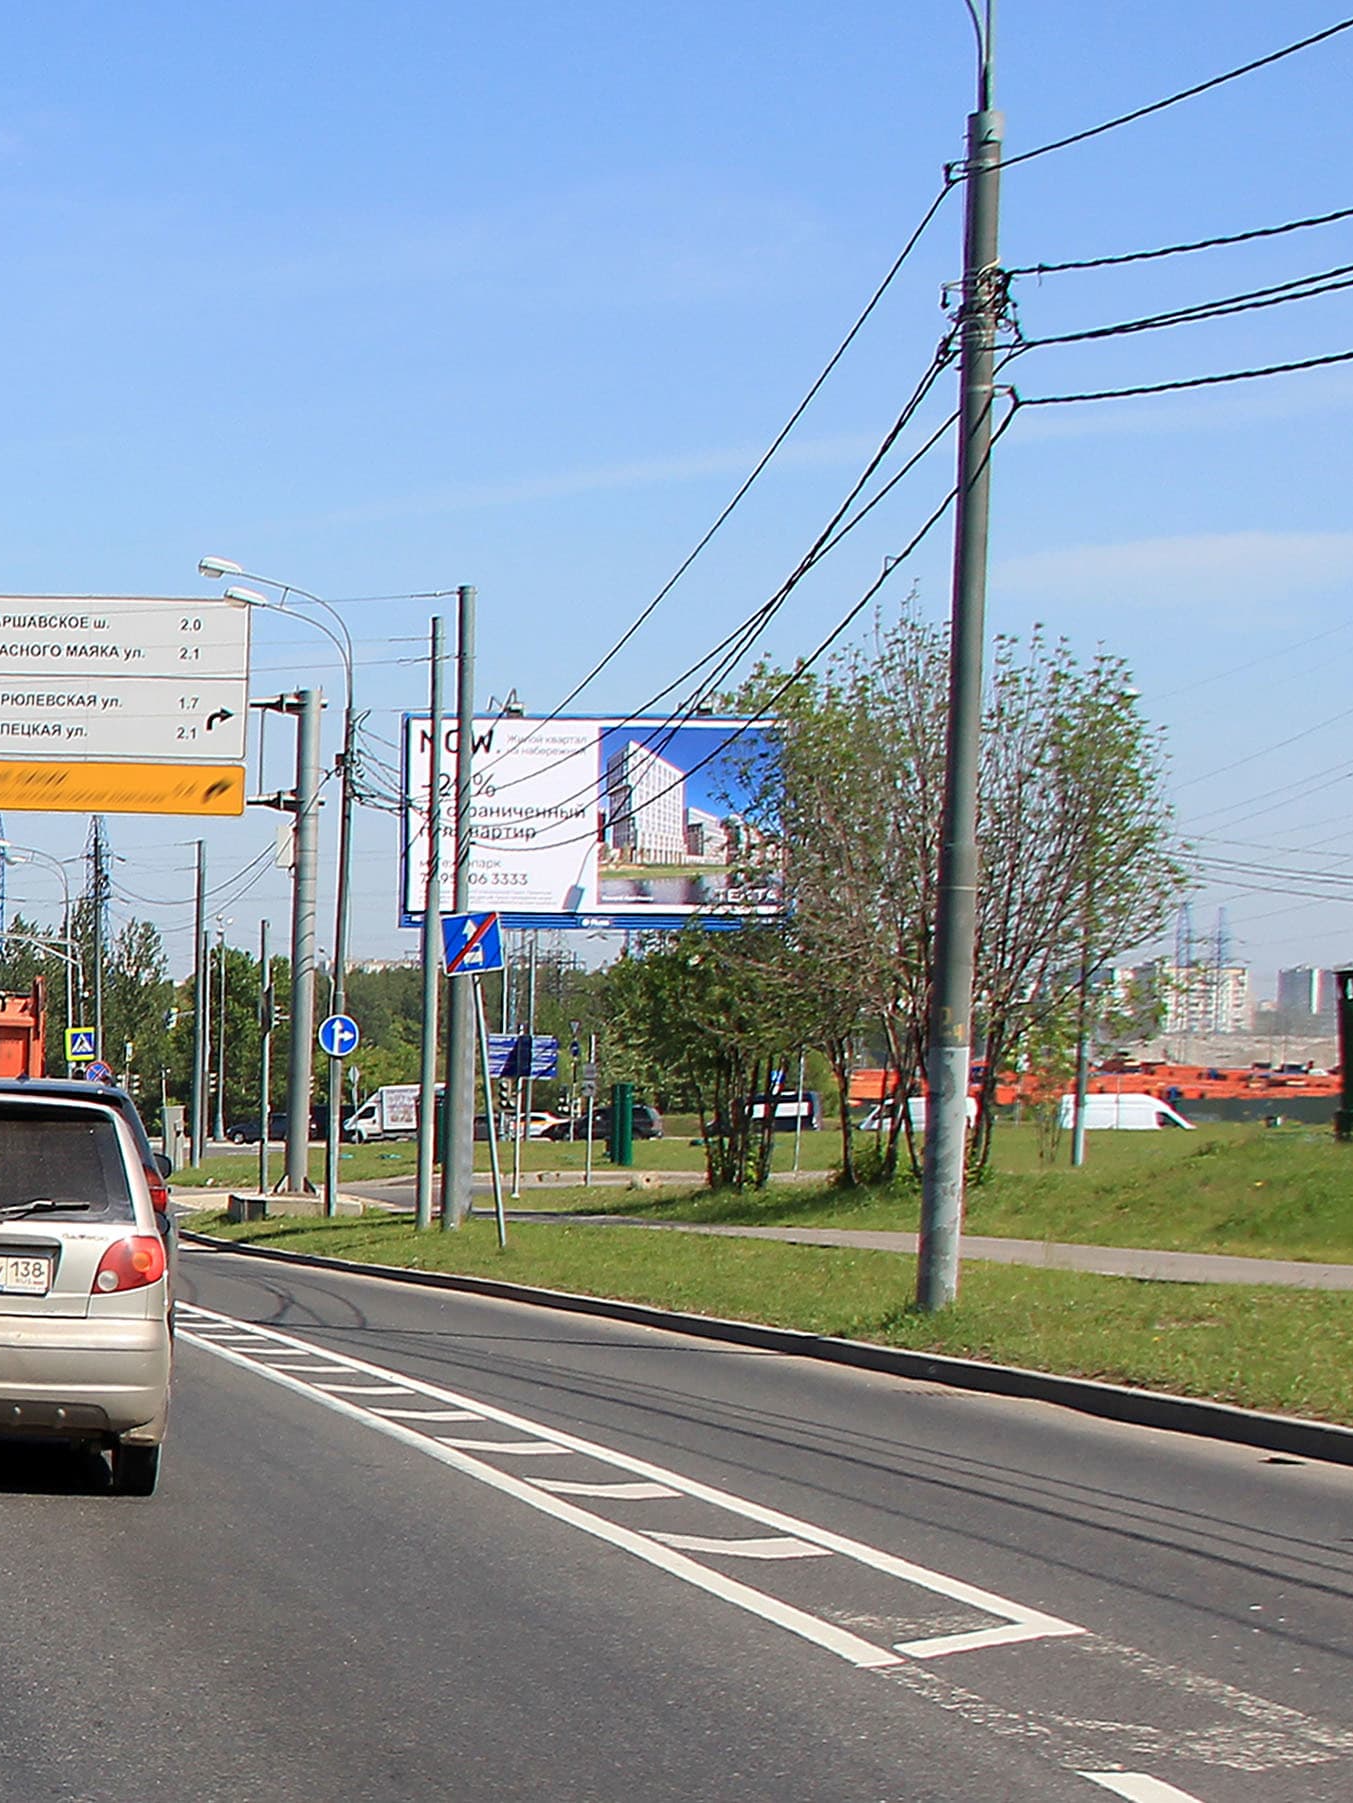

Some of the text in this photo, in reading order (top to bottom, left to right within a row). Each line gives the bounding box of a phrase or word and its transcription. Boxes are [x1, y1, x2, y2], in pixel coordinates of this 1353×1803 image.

[93, 619, 110, 630] ш.
[180, 618, 202, 631] 2.0
[65, 644, 120, 657] МАЯКА
[123, 648, 145, 661] ул.
[179, 647, 199, 660] 2.1
[101, 697, 123, 710] ул.
[178, 697, 199, 709] 1.7
[66, 726, 88, 740] ул.
[176, 727, 197, 740] 2.1
[9, 1260, 44, 1278] 138
